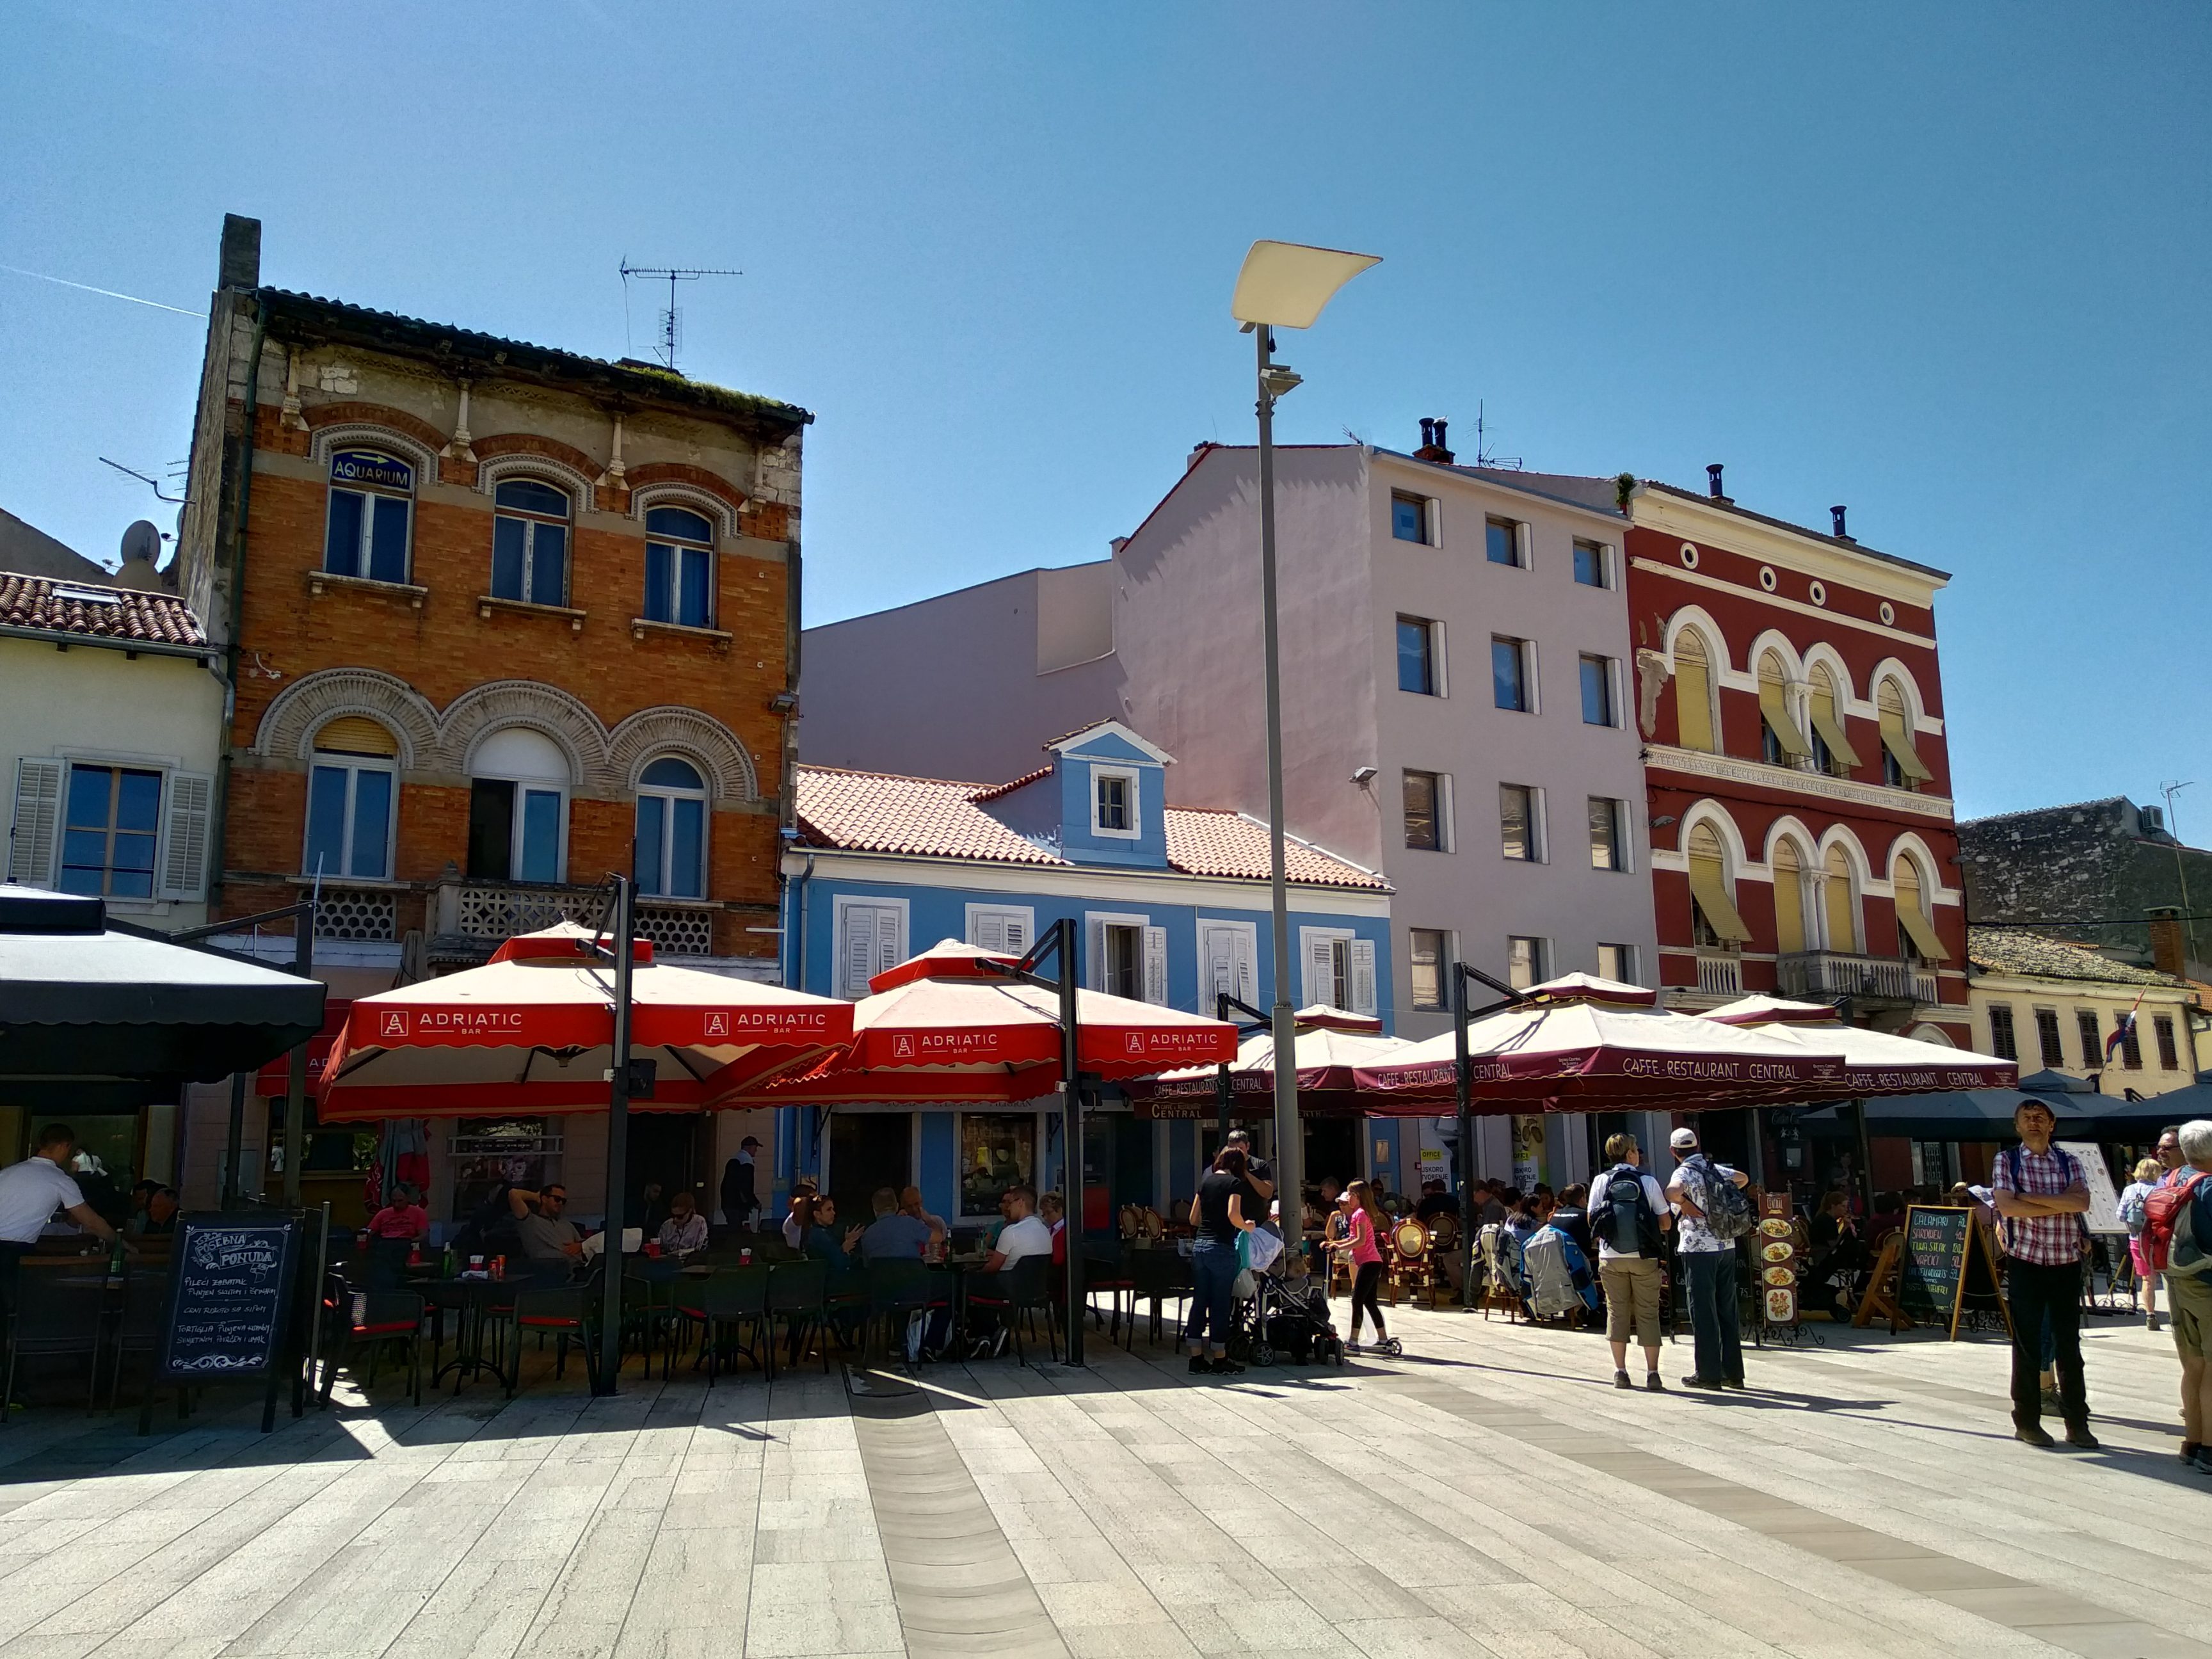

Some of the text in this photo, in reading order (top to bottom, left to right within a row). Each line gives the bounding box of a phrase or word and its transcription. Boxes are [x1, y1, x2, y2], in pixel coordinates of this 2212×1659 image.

[334, 461, 408, 486] AQUARIUM
[419, 1013, 522, 1025] ADRIATIC
[737, 1014, 826, 1025] ADRIATIC
[922, 1034, 997, 1046] ADRIATIC
[1150, 1034, 1218, 1045] ADRIATIC
[1473, 1063, 1512, 1080] CENTRAL
[1749, 1063, 1800, 1079] CENTRAL
[1231, 1077, 1263, 1091] CENTRAL
[1946, 1072, 1987, 1086] CENTRAL
[1151, 1104, 1202, 1118] CENTRAL
[1914, 1215, 1949, 1227] CALAMARI
[198, 1235, 246, 1255] POSEBNA
[221, 1251, 273, 1267] PONUDA
